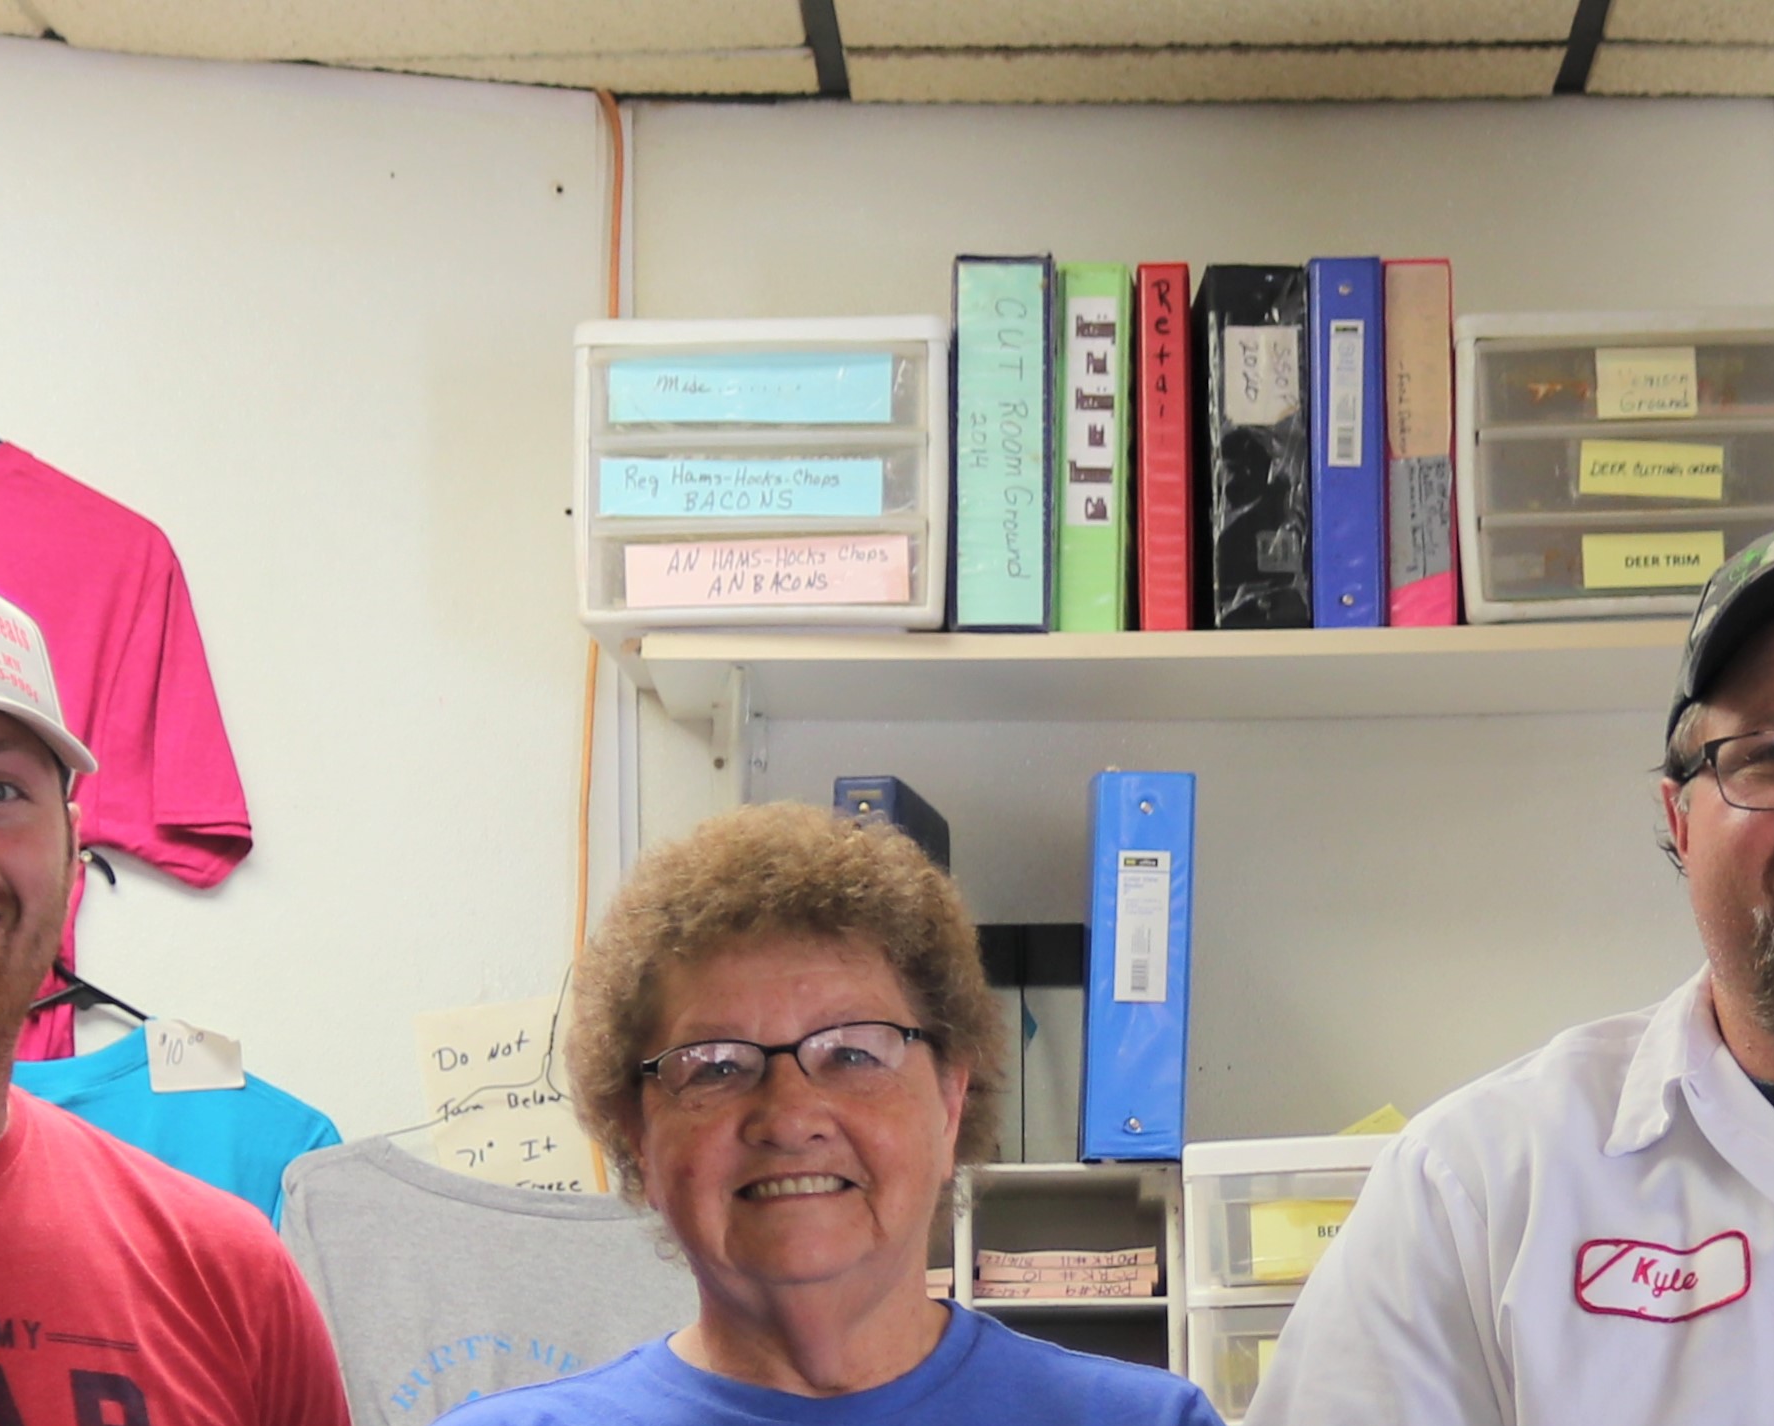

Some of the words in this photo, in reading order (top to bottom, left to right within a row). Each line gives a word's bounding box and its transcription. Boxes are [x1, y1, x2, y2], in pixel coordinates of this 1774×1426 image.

[995, 298, 1028, 381] CUT
[1620, 389, 1690, 414] Ground
[970, 411, 989, 469] 2014
[624, 464, 660, 497] Reg
[1625, 556, 1660, 569] DEER
[1665, 554, 1701, 568] TRIM
[431, 1046, 469, 1072] Do
[519, 1135, 558, 1163] It
[1631, 1256, 1700, 1298] Kyle
